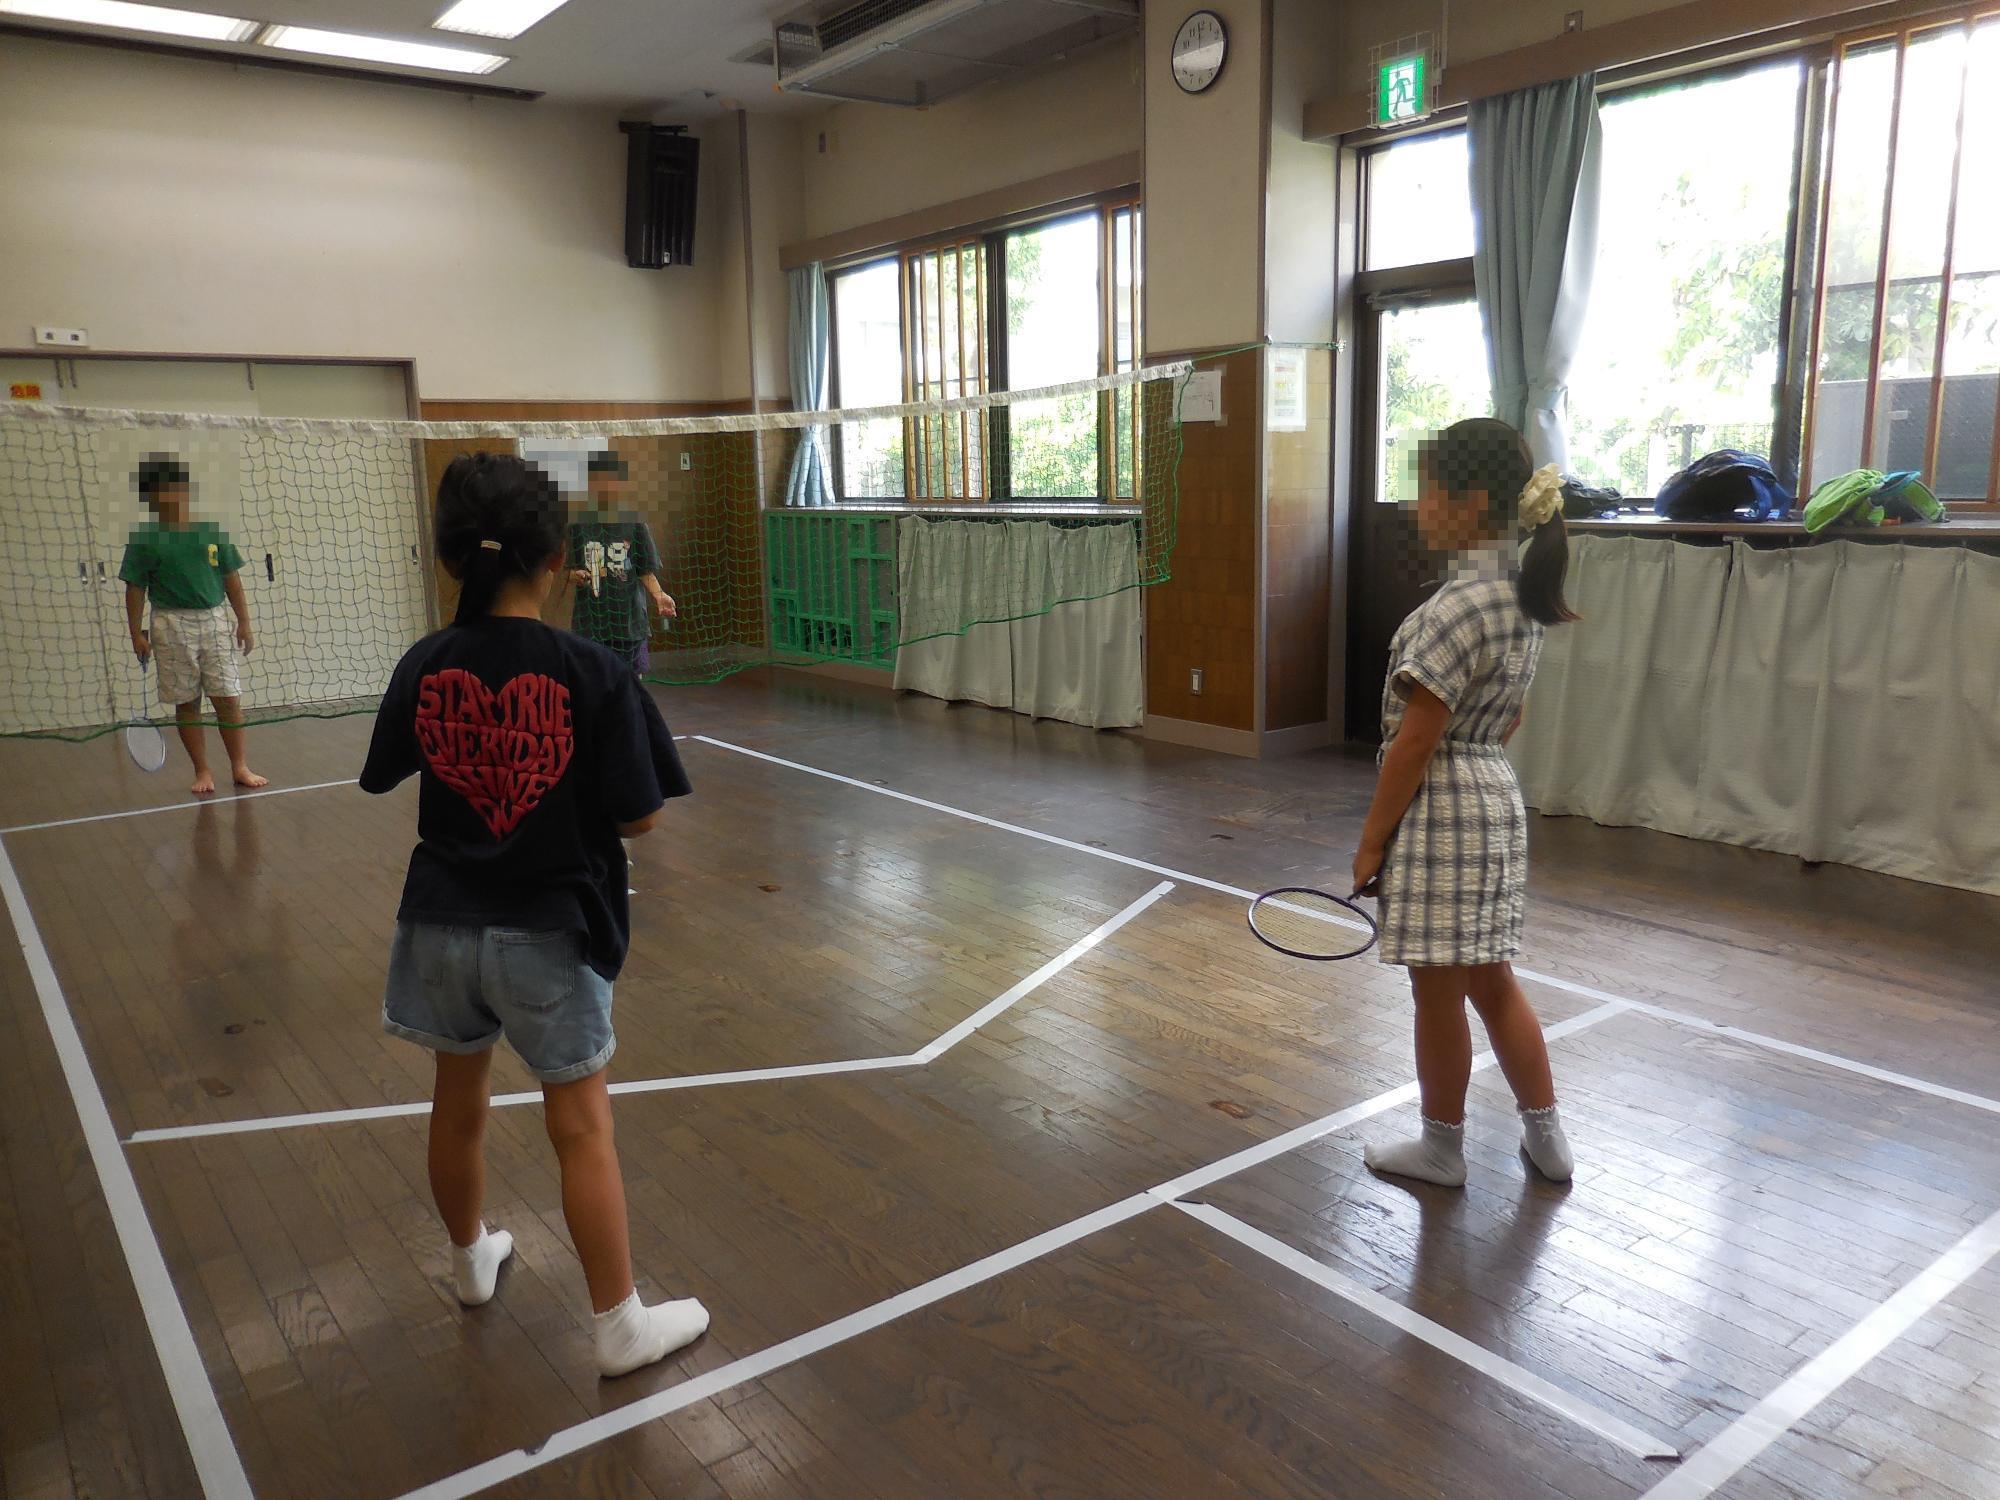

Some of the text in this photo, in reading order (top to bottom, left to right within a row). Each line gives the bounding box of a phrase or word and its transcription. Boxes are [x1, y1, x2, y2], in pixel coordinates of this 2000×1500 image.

[416, 668, 574, 736] STAY TRUE
[415, 717, 574, 778] EVERYDAY
[432, 764, 561, 812] SHINE
